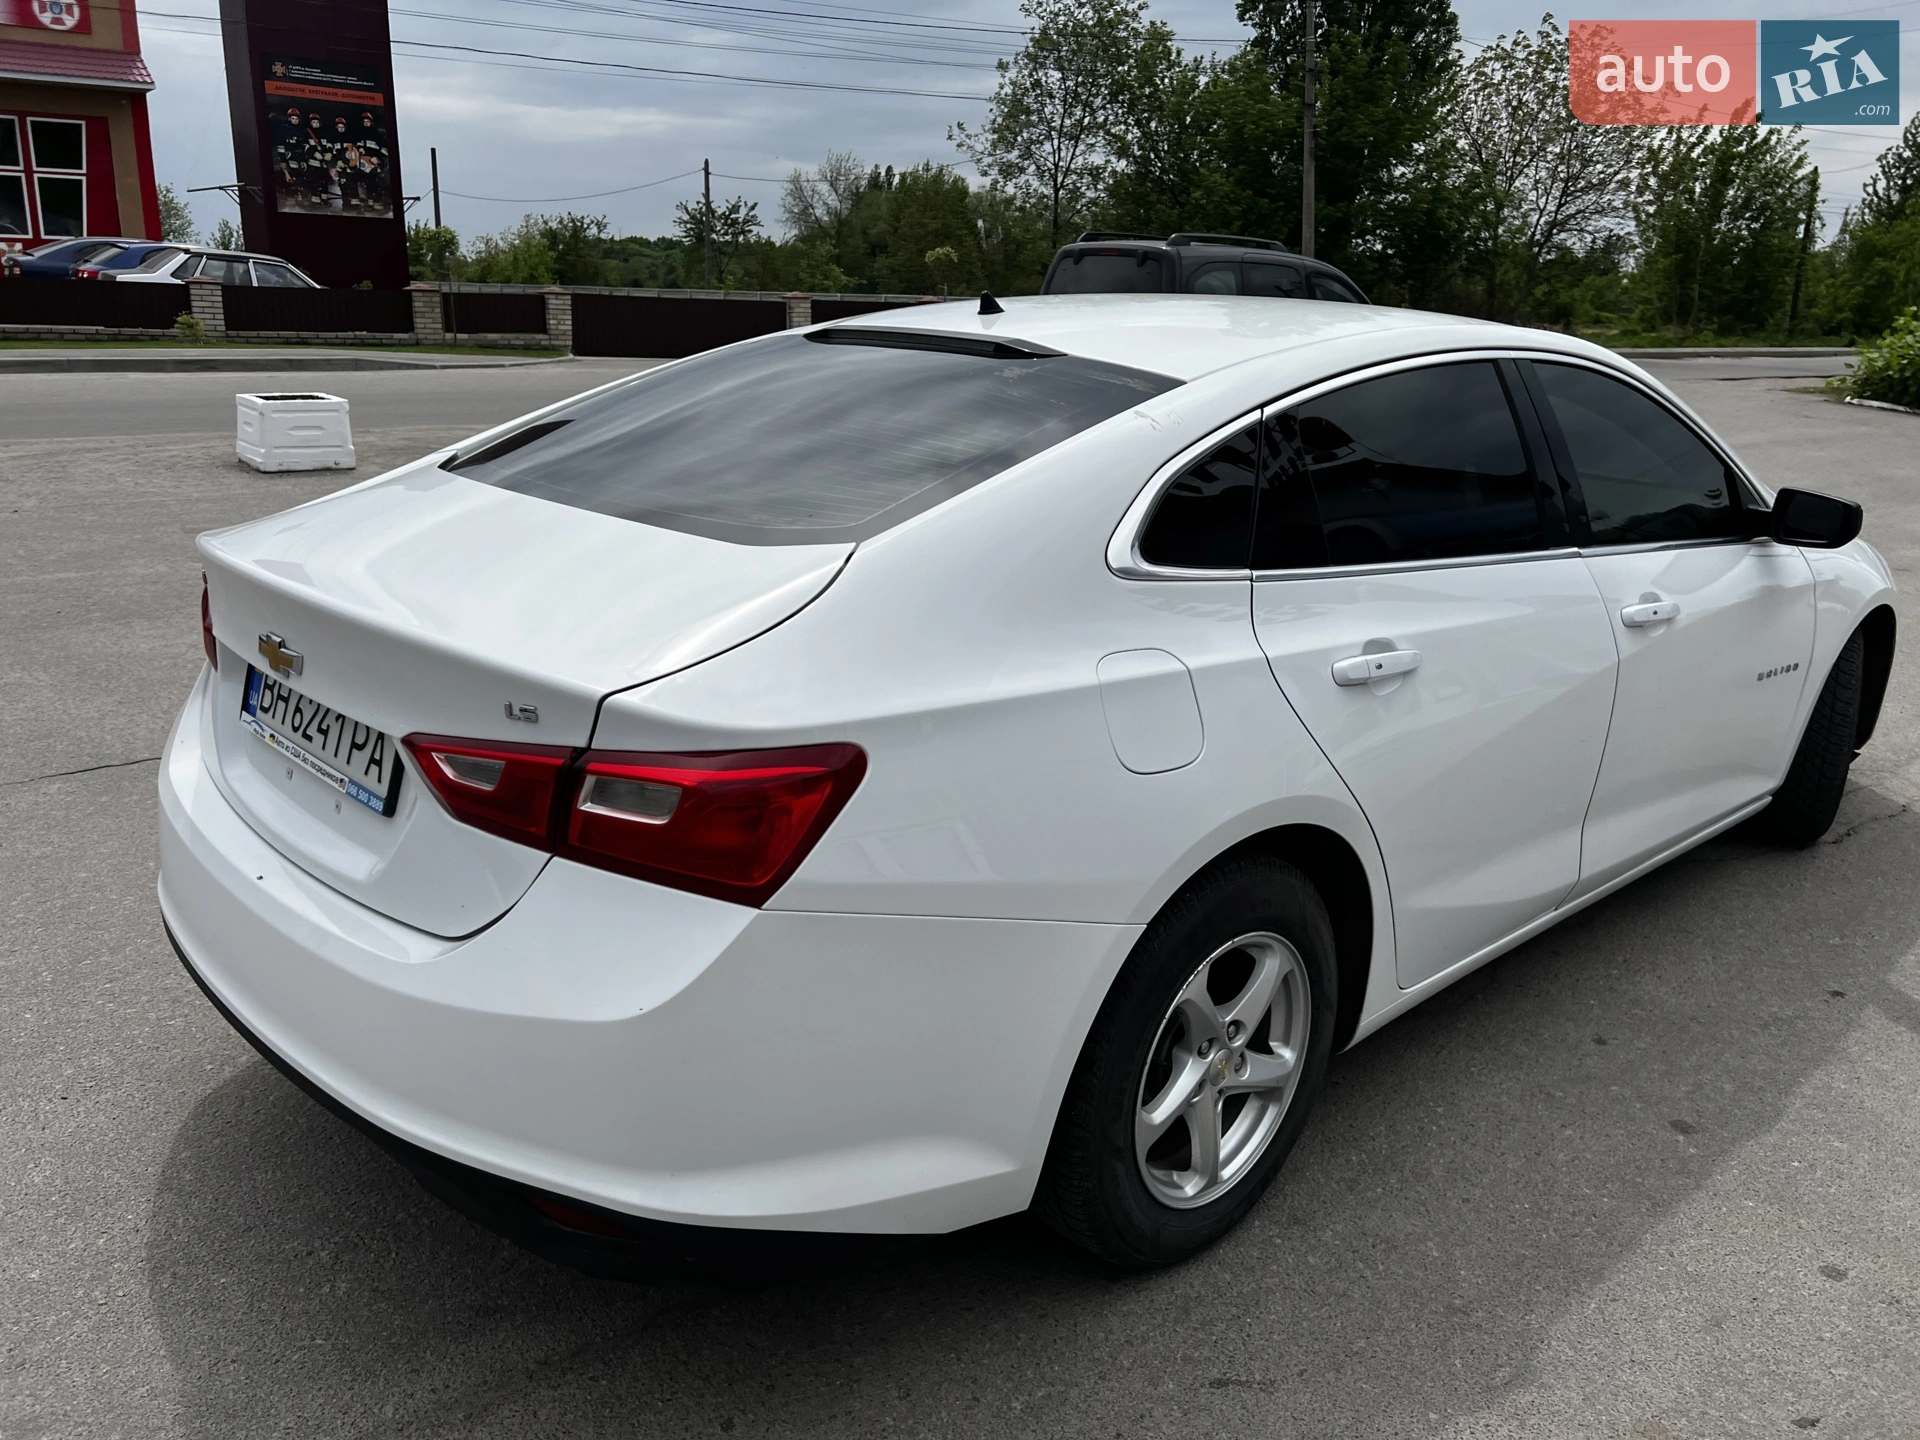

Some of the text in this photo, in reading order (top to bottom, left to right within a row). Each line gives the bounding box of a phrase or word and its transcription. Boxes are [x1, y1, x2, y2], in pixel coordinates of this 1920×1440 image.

[249, 690, 258, 708] UA
[504, 700, 539, 723] LS
[259, 673, 385, 784] BH 6241 PA
[291, 746, 302, 760] США
